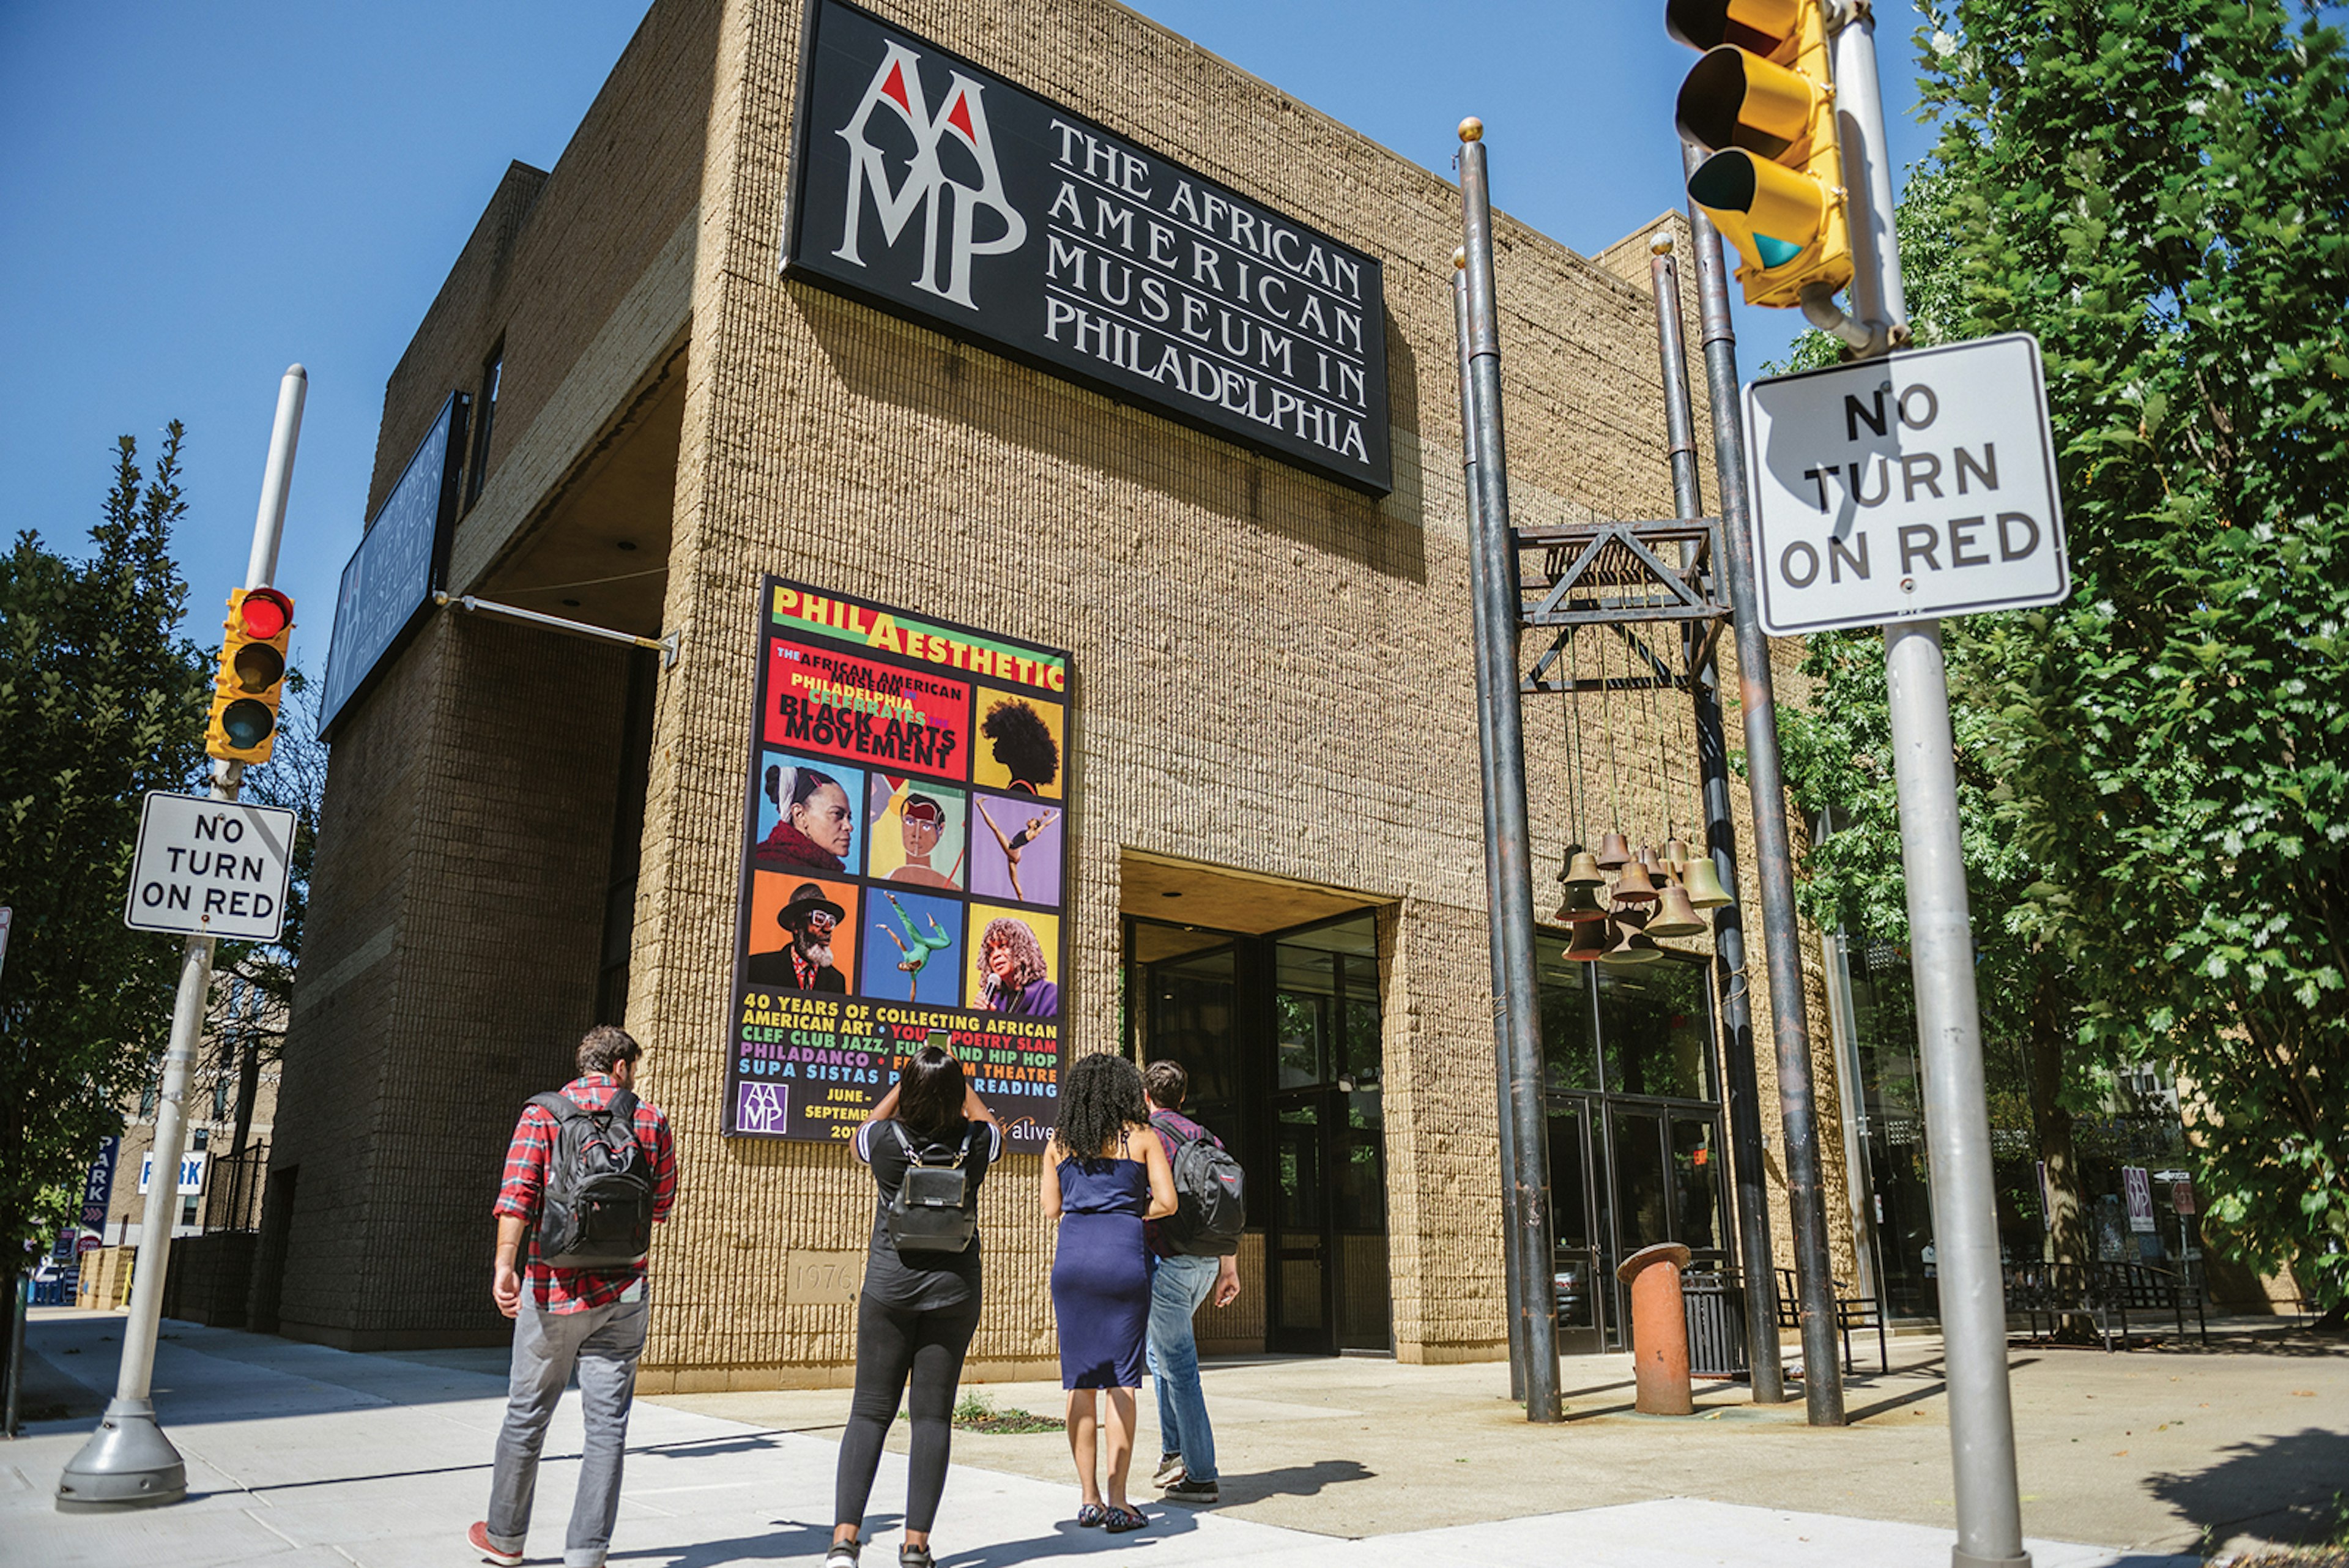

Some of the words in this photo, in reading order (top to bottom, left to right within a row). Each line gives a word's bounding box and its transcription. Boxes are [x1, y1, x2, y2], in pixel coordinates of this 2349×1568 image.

[1050, 118, 1152, 201] THE
[1167, 180, 1361, 301] AFRICAN
[1048, 180, 1364, 354] AMERICAN
[1046, 234, 1294, 377] MUSEUM
[1316, 352, 1367, 408] IN
[1044, 295, 1370, 464] PHILADELPHIA
[1844, 384, 1939, 441] NO
[1805, 442, 1998, 515] TURN
[1780, 532, 1871, 589] ON
[1898, 511, 2040, 574] RED
[773, 585, 1064, 693] PHILAESTHETIC
[777, 647, 800, 661] THE
[800, 654, 873, 678] AFRICAN
[881, 672, 961, 700] AMERICAN
[791, 673, 914, 712] PHILADELPHIA
[831, 671, 901, 697] MUSEUM
[904, 689, 917, 700] IN
[779, 694, 874, 734] BLACK
[885, 718, 956, 751] ARTS
[808, 689, 926, 727] CELEBRATES
[929, 716, 948, 728] THE
[785, 712, 951, 769] MOVEMENT
[194, 814, 244, 844] NO
[167, 847, 264, 883] TURN
[143, 882, 191, 910] ON
[204, 888, 274, 919] RED
[741, 1009, 836, 1033] AMERICAN
[840, 1019, 874, 1036] ART
[951, 1030, 1013, 1049] POETRY
[1016, 1037, 1057, 1053] SLAM
[743, 992, 771, 1009] 40
[777, 995, 839, 1017] YEARS
[845, 1003, 870, 1020] OF
[875, 1008, 980, 1032] COLLECTING
[985, 1019, 1058, 1039] AFRICAN
[740, 1042, 870, 1067] PHILADANCO
[982, 1063, 1057, 1083] THEATRE
[741, 1025, 784, 1043] CLEF
[790, 1030, 836, 1048] CLUB
[842, 1035, 890, 1055] JAZZ,
[989, 1049, 1017, 1064] HIP
[1022, 1051, 1058, 1068] HOP
[738, 1058, 796, 1077] SUPA
[806, 1064, 879, 1085] SISTAS
[974, 1079, 1058, 1098] READING
[1012, 1120, 1055, 1140] alive
[89, 1135, 114, 1201] PARK
[796, 1264, 853, 1291] 1976
